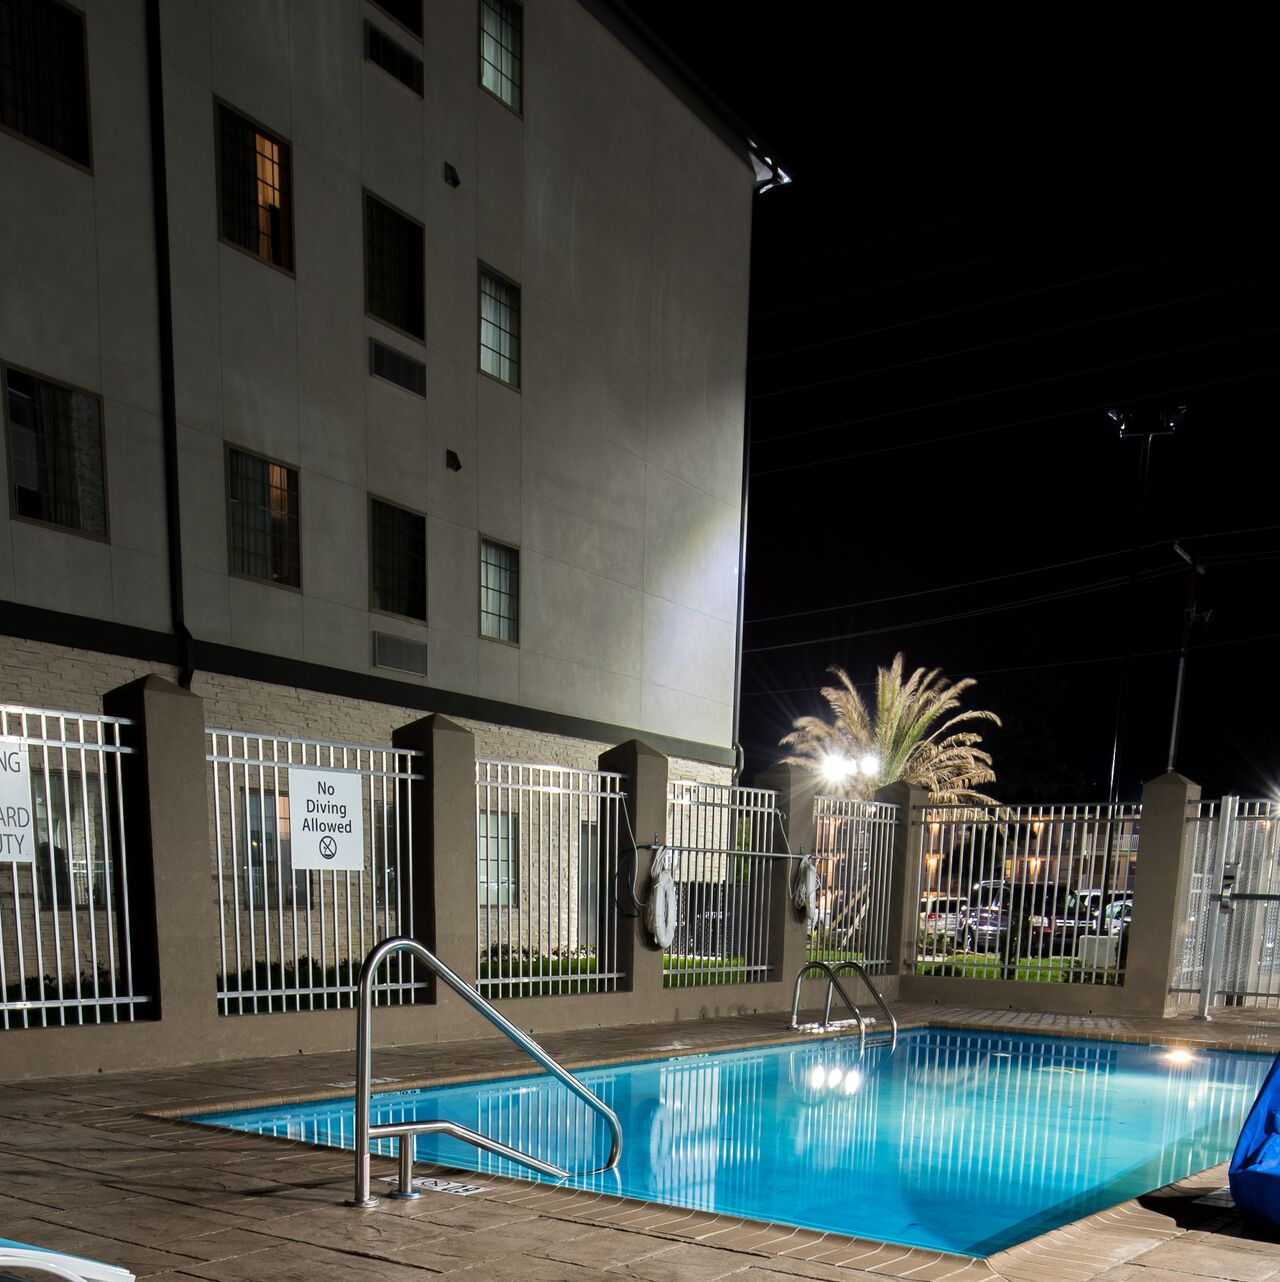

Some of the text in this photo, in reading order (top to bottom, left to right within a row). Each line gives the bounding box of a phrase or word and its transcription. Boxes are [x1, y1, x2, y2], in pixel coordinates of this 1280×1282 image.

[317, 781, 335, 796] No
[306, 799, 347, 818] Diving
[302, 818, 352, 834] Allowed
